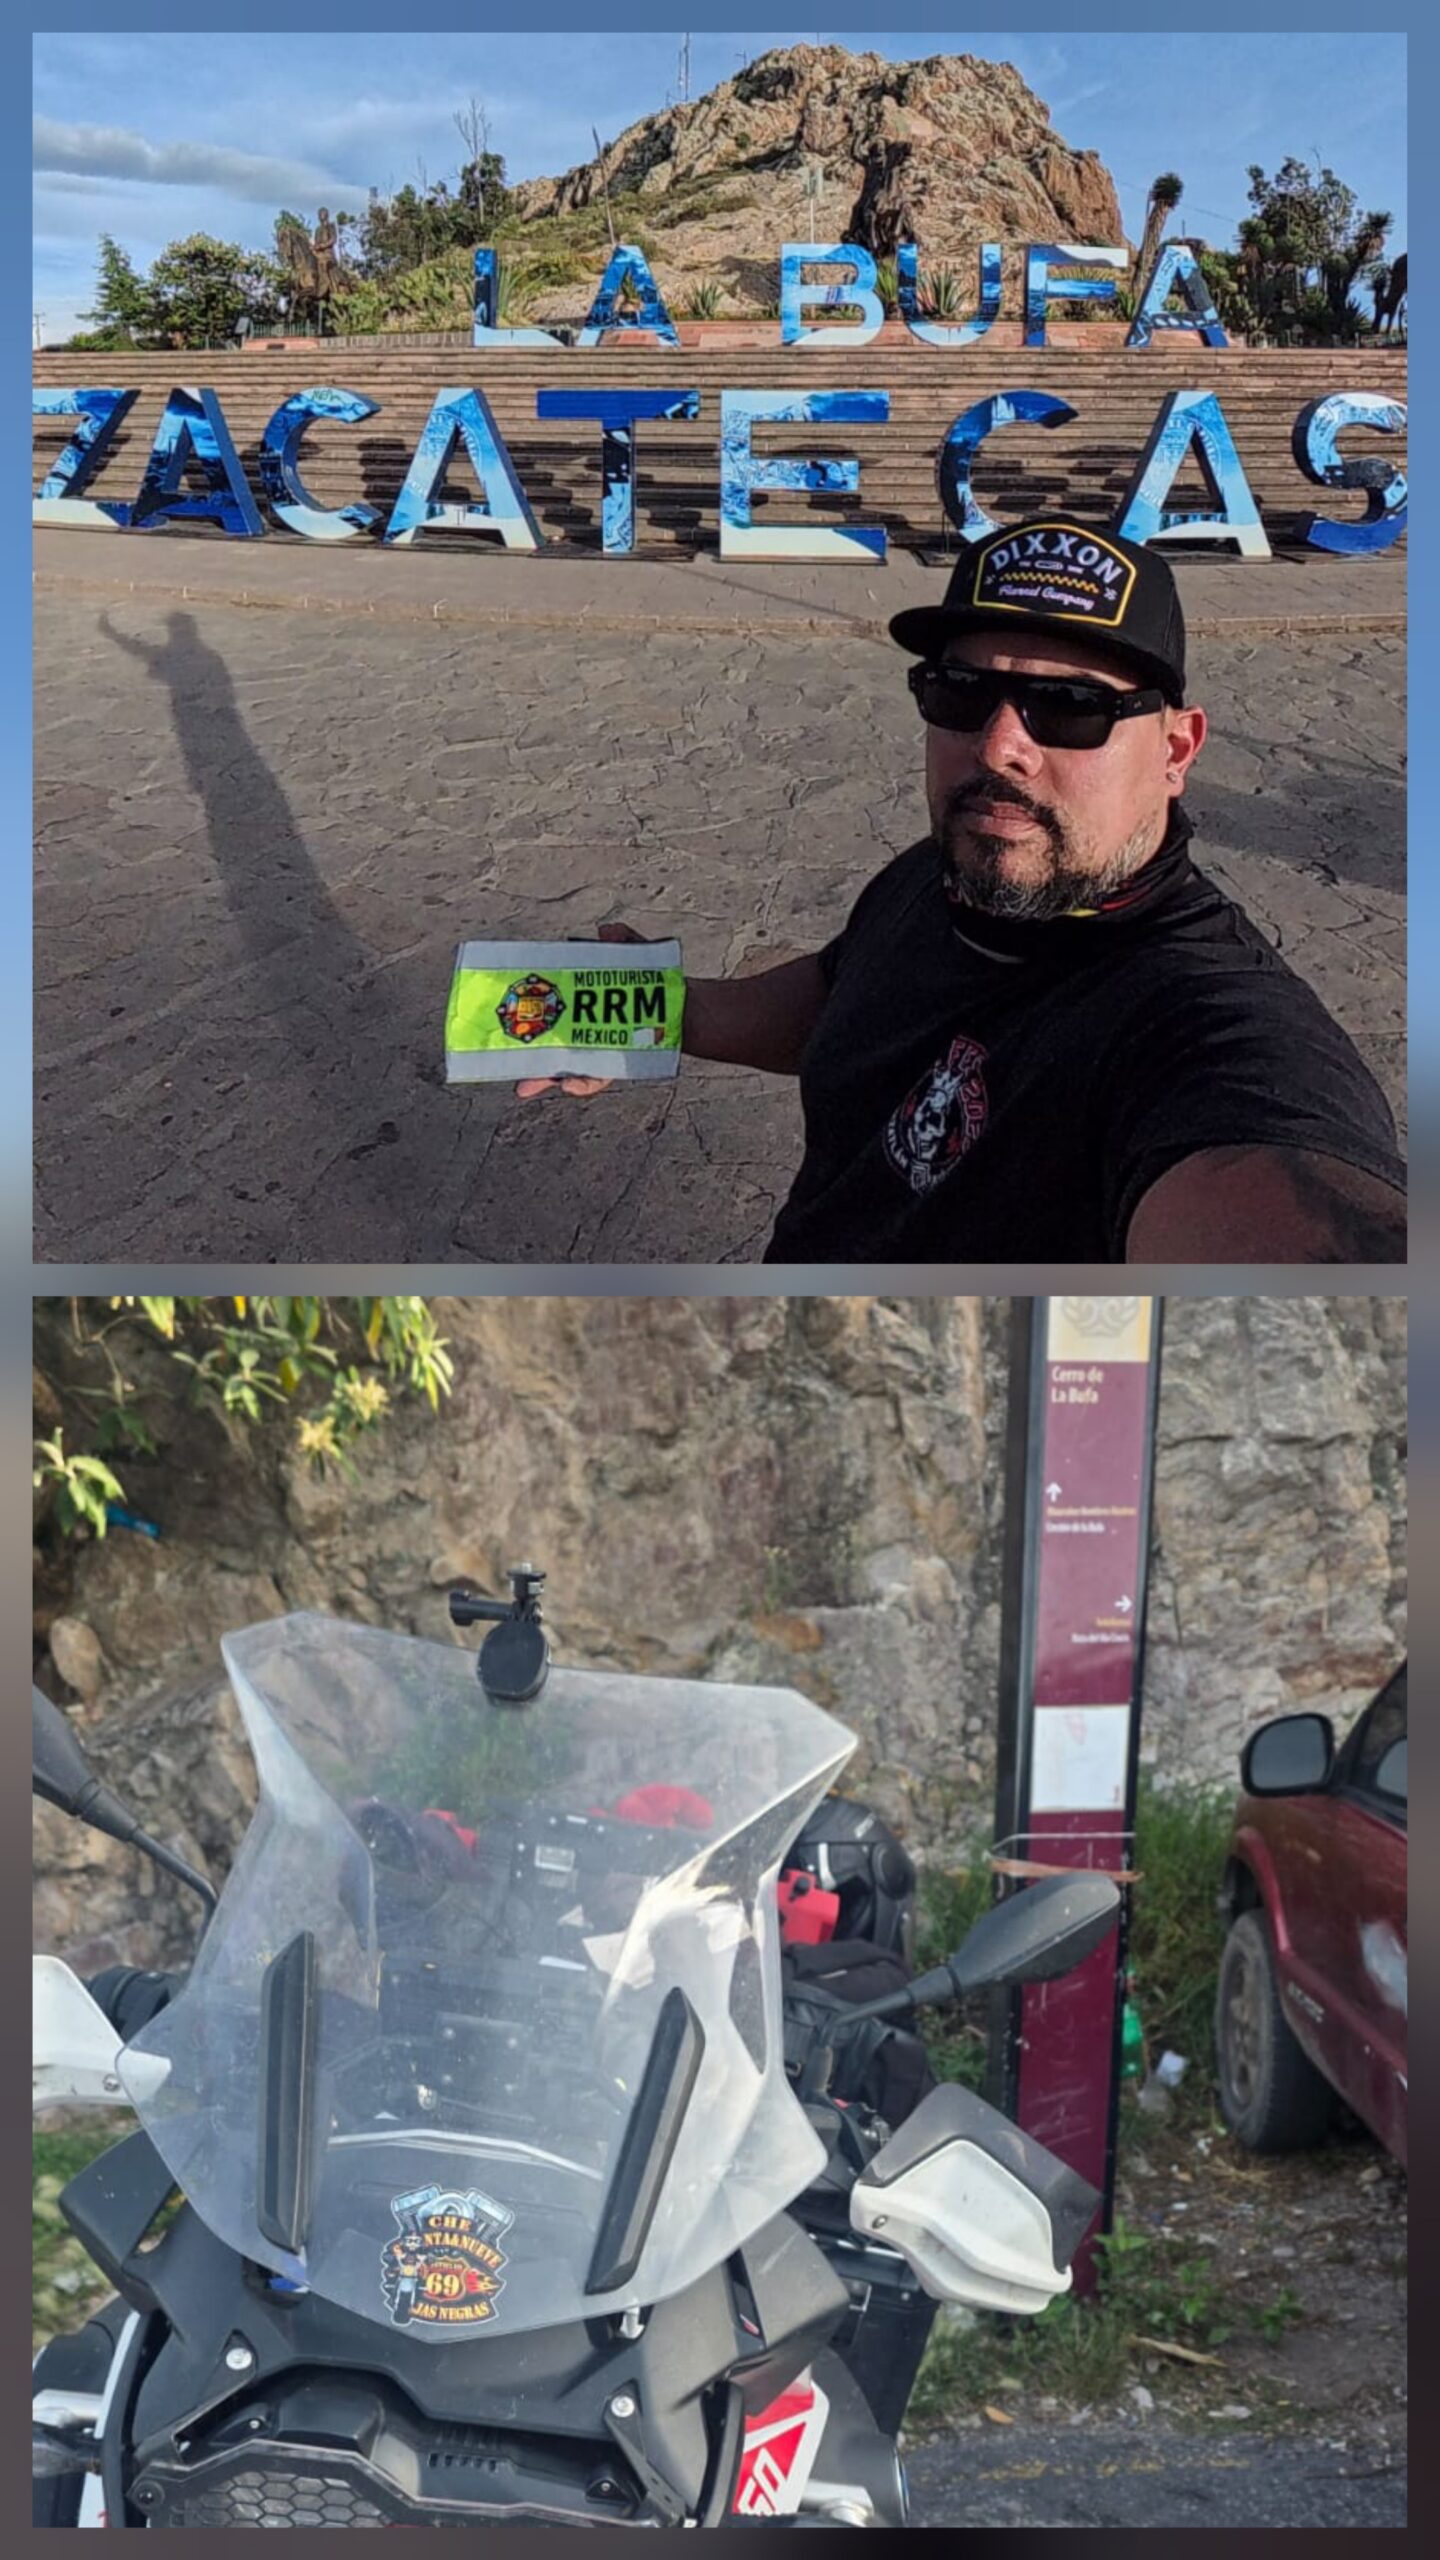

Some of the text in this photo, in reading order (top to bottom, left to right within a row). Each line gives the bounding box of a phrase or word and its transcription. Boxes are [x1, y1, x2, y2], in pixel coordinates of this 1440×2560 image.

[473, 242, 1230, 348] LA BUFA
[32, 386, 1408, 563] ZACATECAS
[990, 533, 1124, 584] DIXXON
[574, 970, 666, 987] MOTOTURISTA
[572, 987, 666, 1025] RRM
[571, 1027, 629, 1045] MEXICO
[1052, 1366, 1104, 1383] Cerro de
[1051, 1386, 1099, 1404] La Bufa
[428, 2216, 473, 2232] CHE
[426, 2272, 460, 2297] 69
[439, 2301, 490, 2320] NEGRAS
